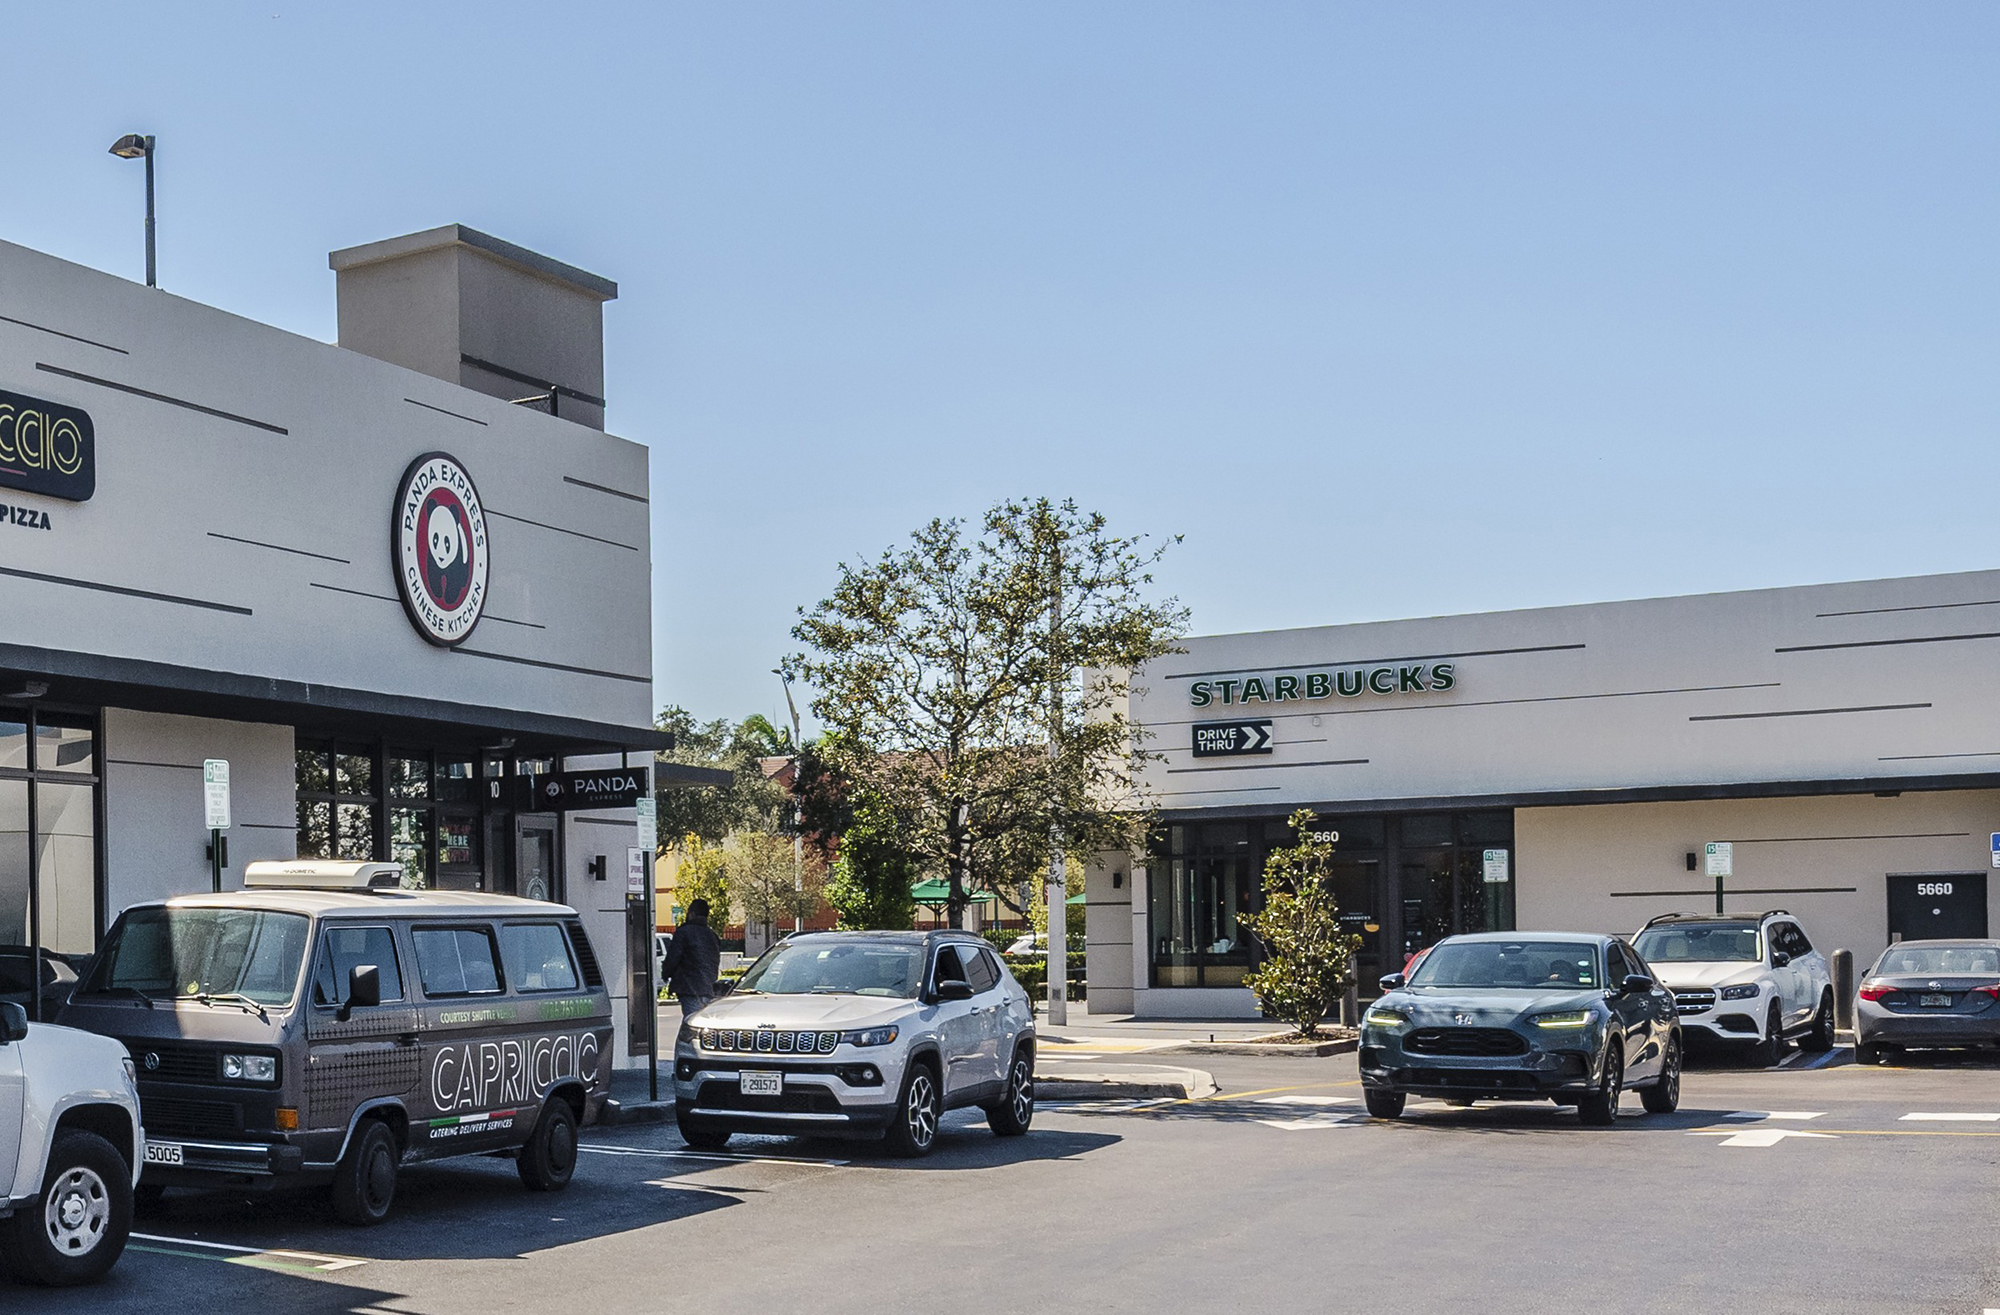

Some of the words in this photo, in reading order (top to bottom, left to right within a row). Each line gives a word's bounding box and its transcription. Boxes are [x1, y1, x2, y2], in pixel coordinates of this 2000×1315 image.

[404, 466, 438, 532] PANDA
[441, 464, 484, 548] EXPRESS
[0, 503, 51, 531] PIZZA
[408, 566, 444, 632] CHINESE
[448, 584, 482, 633] KITCHEN
[1189, 663, 1456, 707] STARBUCKS
[1197, 728, 1237, 741] DRIVE
[1198, 740, 1235, 752] THRU
[206, 763, 213, 779] 15
[490, 781, 500, 798] 10
[574, 776, 638, 793] PANDA
[1313, 831, 1339, 843] 660
[1486, 852, 1493, 860] 15
[1707, 845, 1716, 853] 15
[1917, 882, 1953, 895] 5660
[440, 1010, 471, 1024] COURTESY
[471, 1009, 496, 1022] SHUTTLE
[431, 1032, 599, 1112] CAPRICCIO
[749, 1079, 778, 1091] 291573
[429, 1126, 459, 1139] CATERING
[459, 1122, 488, 1135] DELIVERY
[487, 1118, 513, 1131] SERVICES
[147, 1145, 181, 1163] 5005
